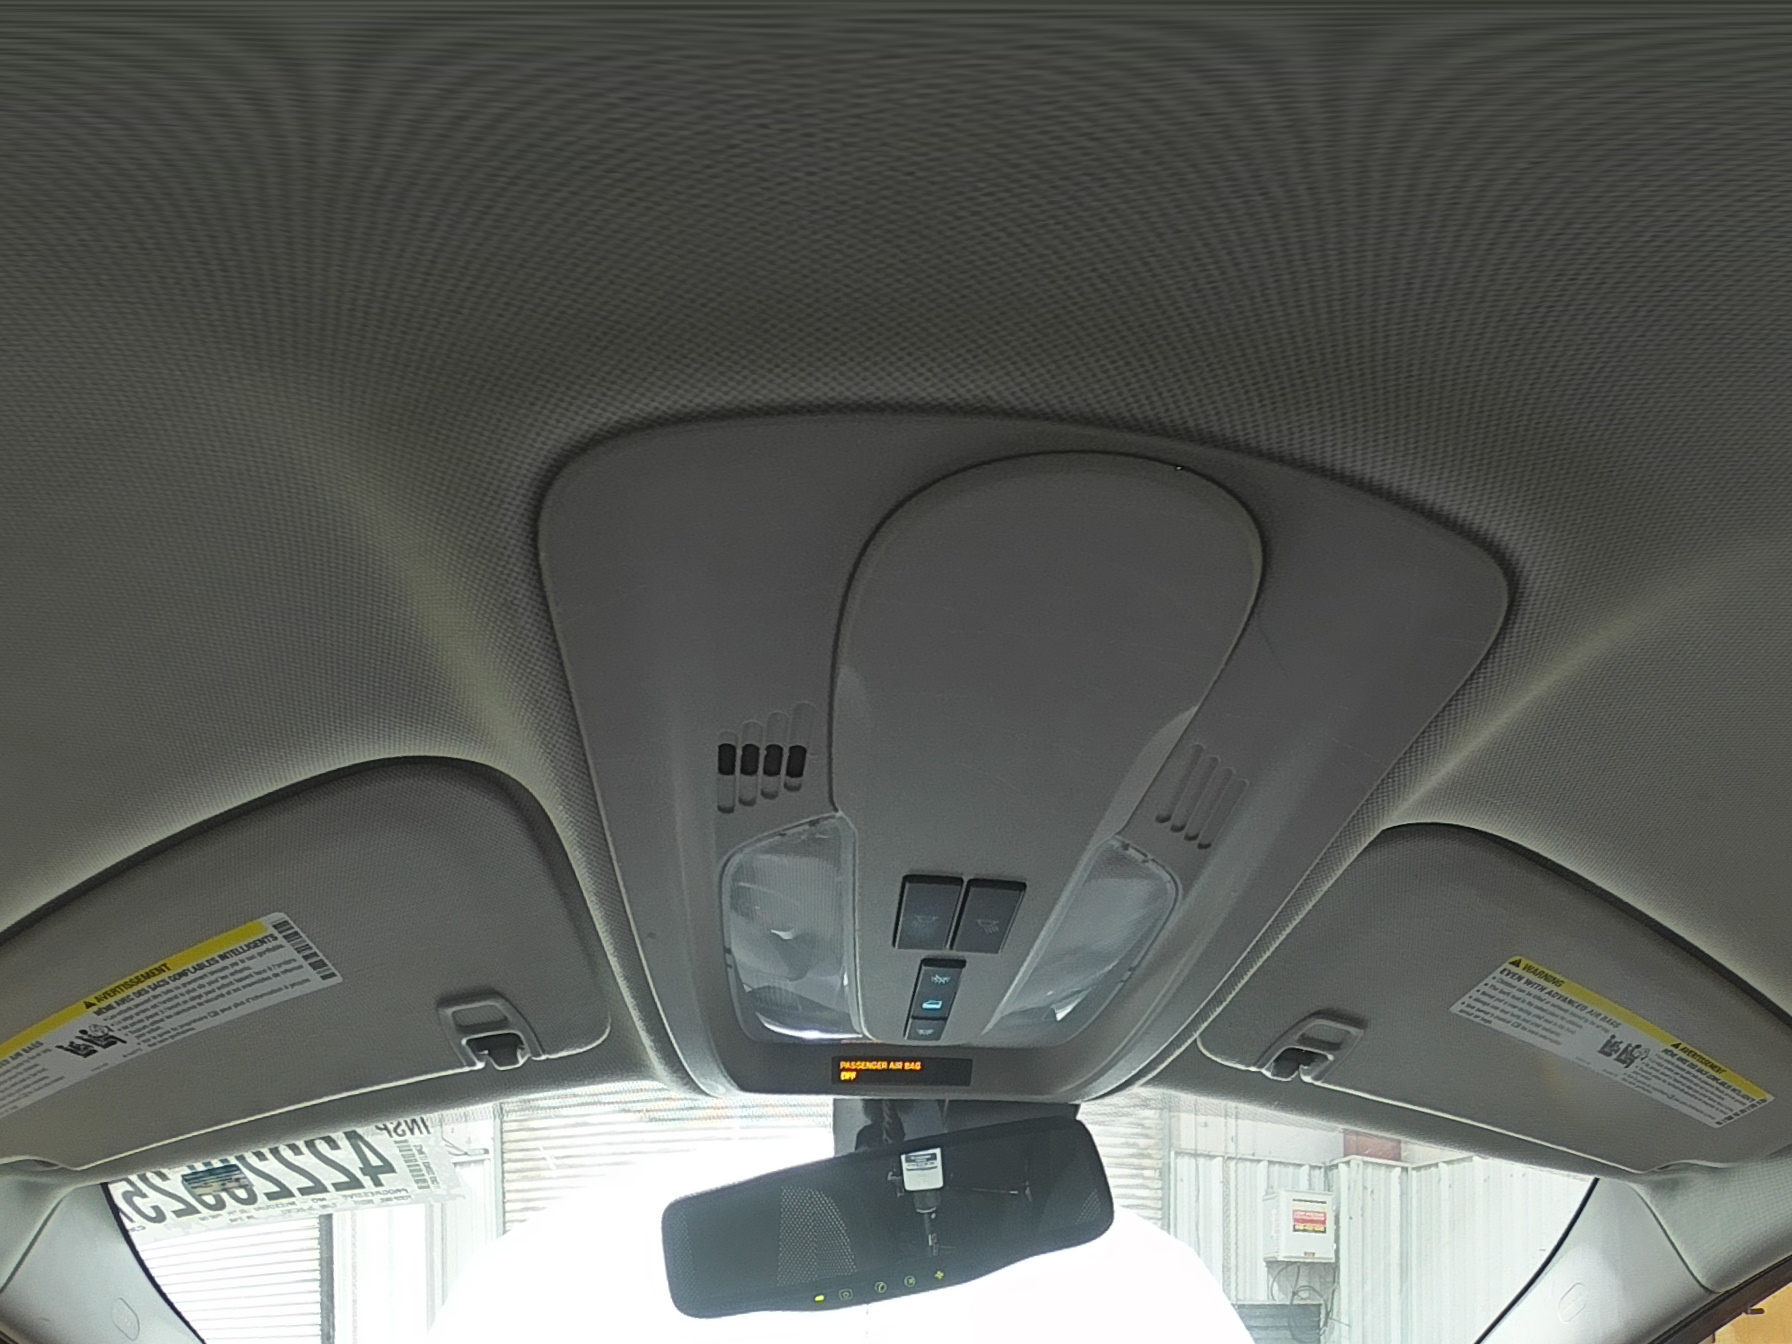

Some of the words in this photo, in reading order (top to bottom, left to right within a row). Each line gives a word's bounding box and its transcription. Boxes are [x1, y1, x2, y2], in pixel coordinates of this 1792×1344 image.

[217, 933, 279, 962] INTELLIGENTS
[93, 963, 172, 1004] AVERTISSEMENT
[1499, 968, 1522, 982] EVEN
[1523, 978, 1545, 993] WITH
[1546, 990, 1587, 1011] ADVANCED
[1522, 963, 1565, 988] WARNING
[839, 1061, 888, 1070] PASSENGER
[889, 1061, 903, 1070] AIR
